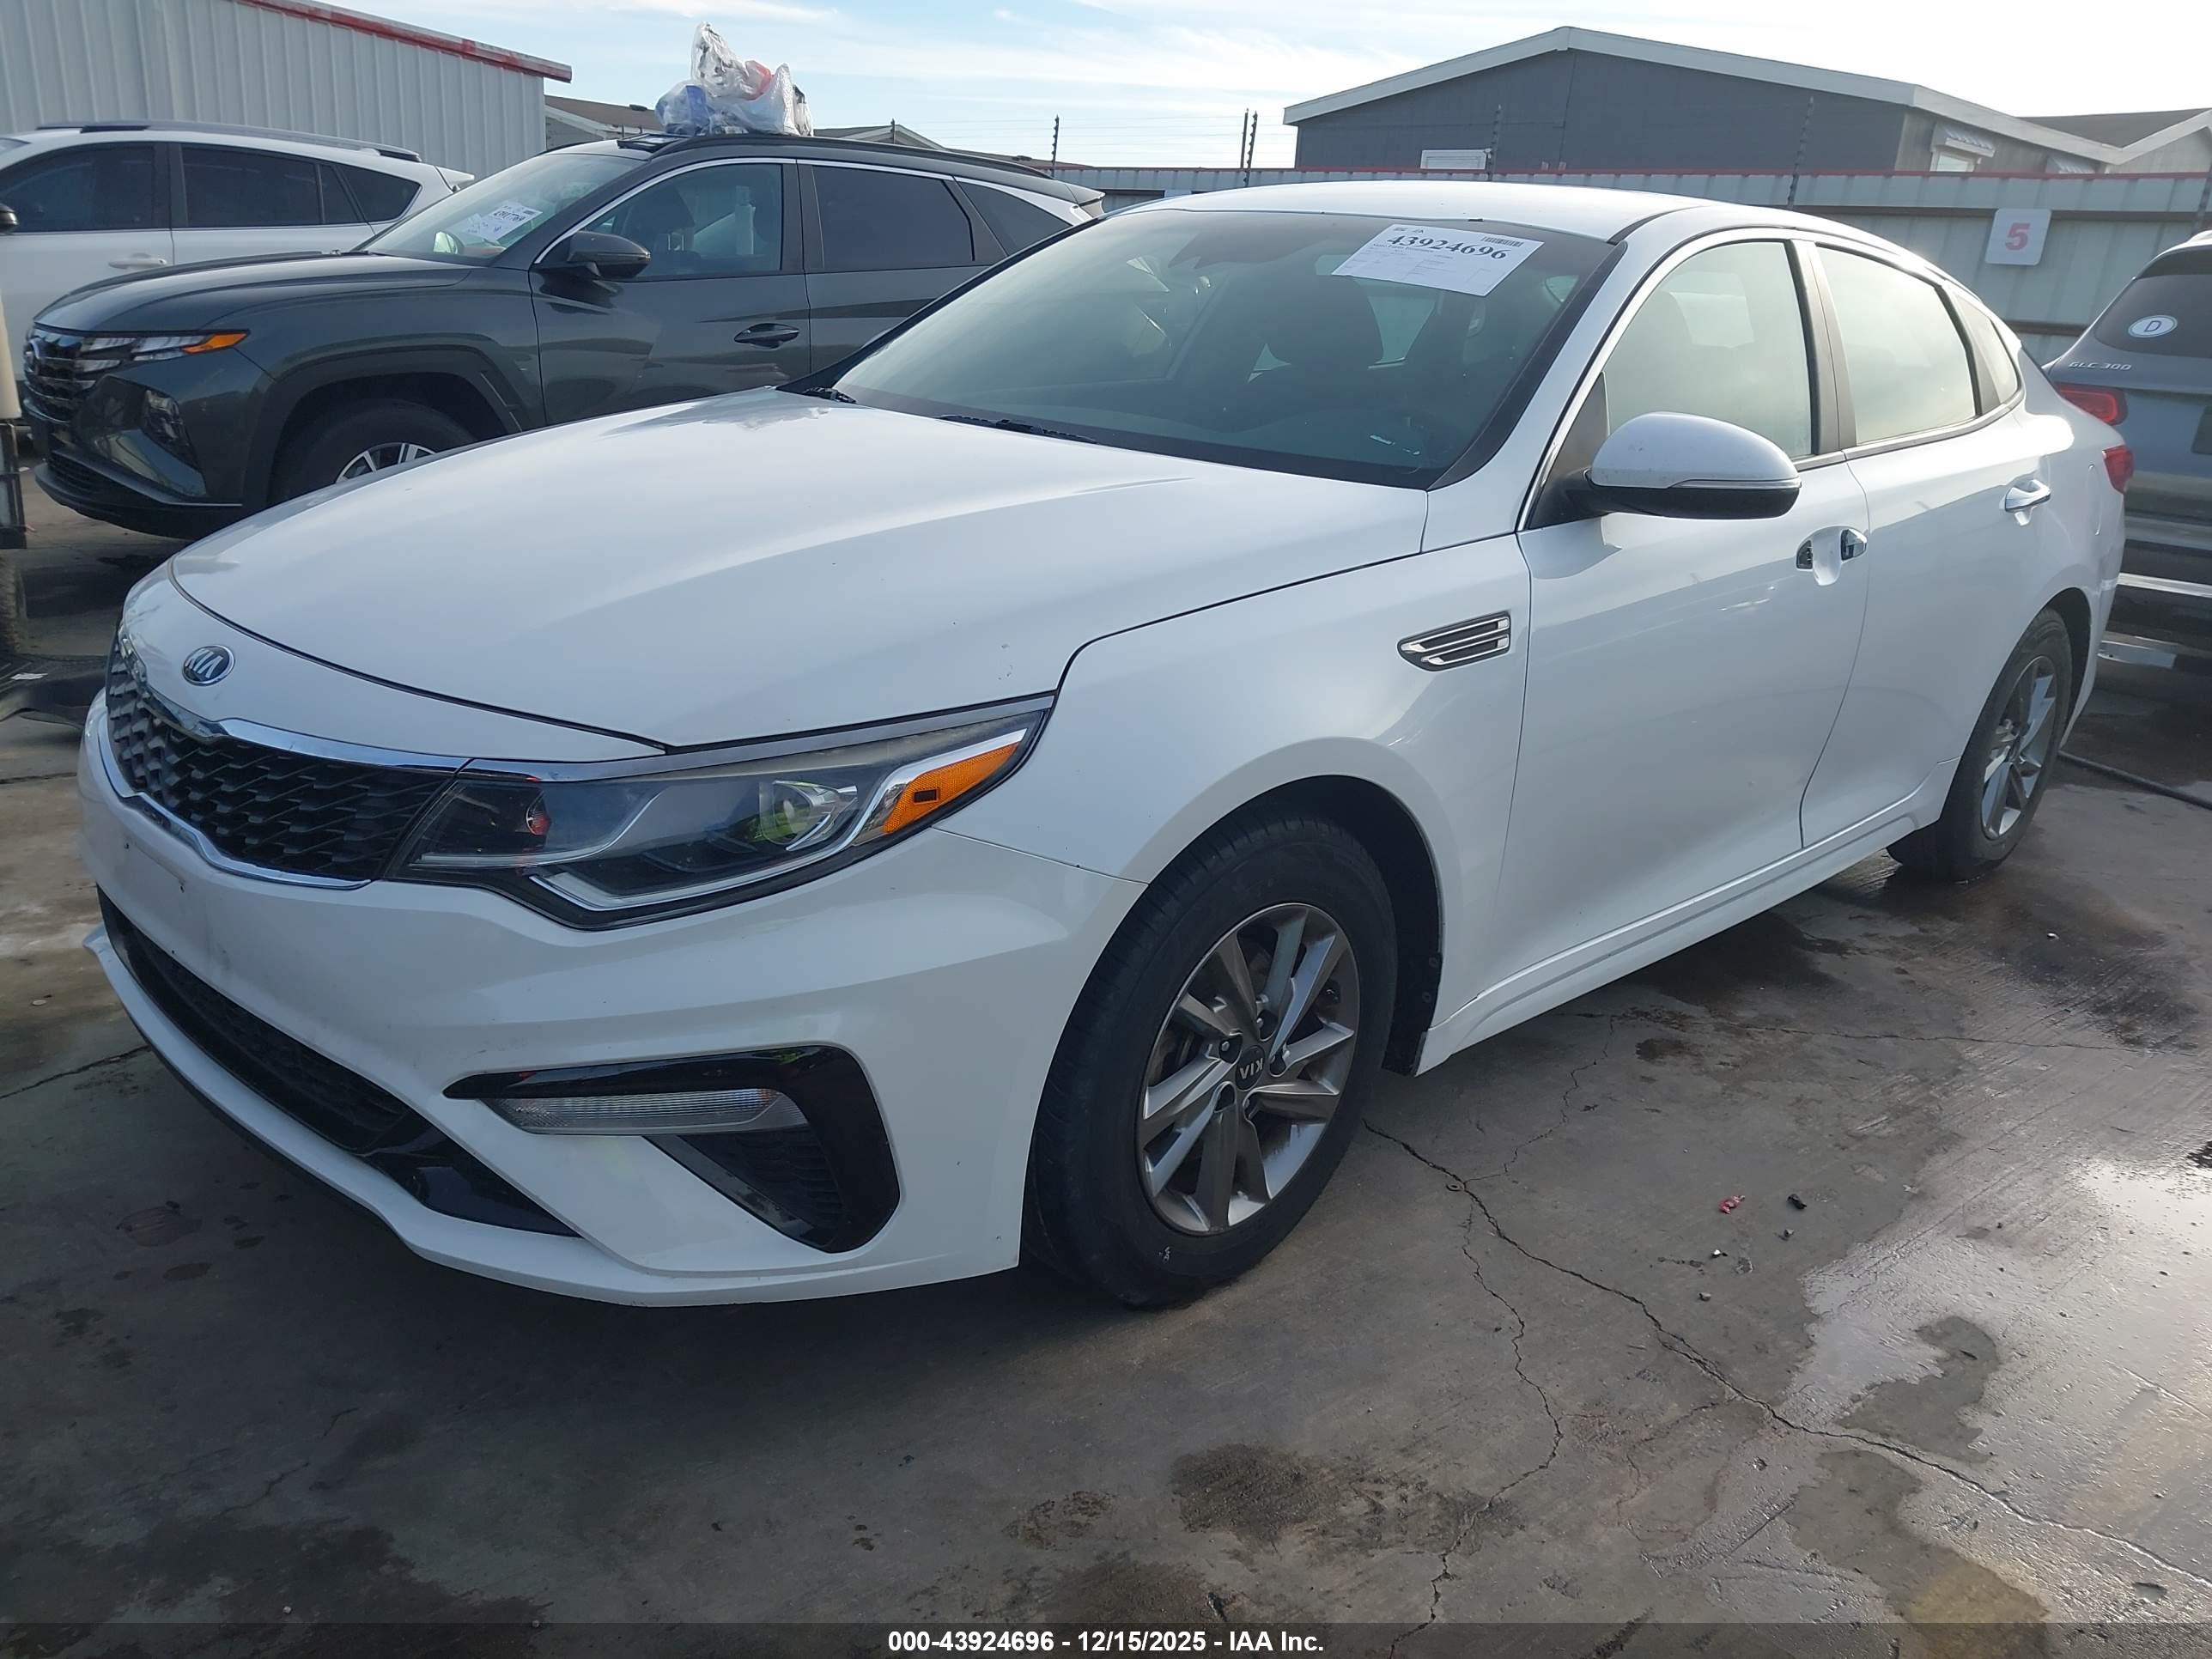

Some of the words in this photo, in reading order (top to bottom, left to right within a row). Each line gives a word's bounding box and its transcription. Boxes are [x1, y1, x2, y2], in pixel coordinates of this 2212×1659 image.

[1386, 234, 1513, 259] 43924696
[2004, 222, 2031, 251] 5
[2143, 319, 2162, 333] D
[2068, 361, 2099, 369] GLC
[2100, 362, 2132, 371] 300
[183, 647, 224, 679] KIA
